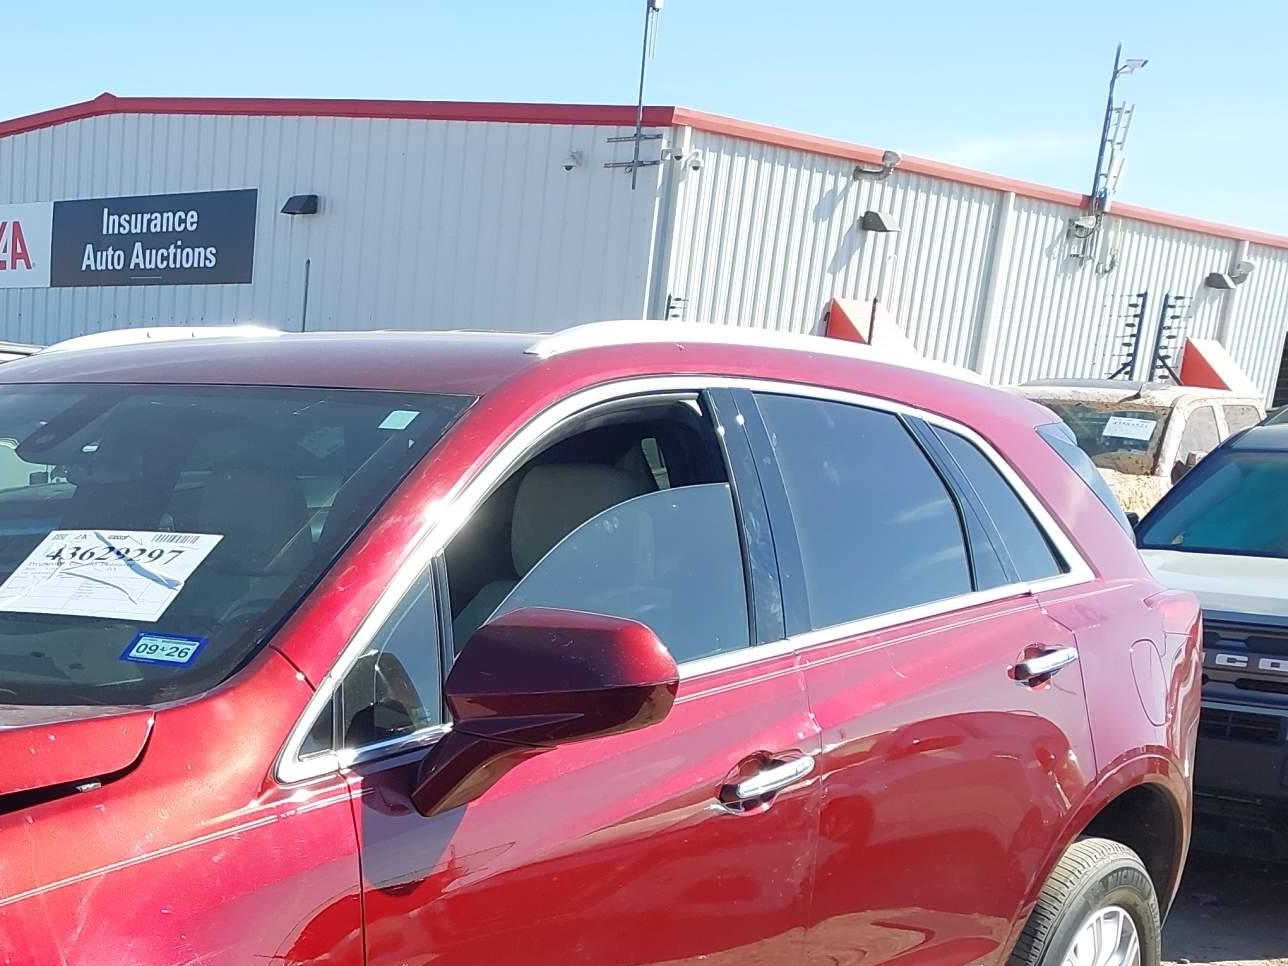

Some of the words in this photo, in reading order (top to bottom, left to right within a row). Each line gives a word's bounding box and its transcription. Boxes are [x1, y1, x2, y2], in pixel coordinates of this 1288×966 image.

[102, 207, 198, 235] Insurance
[81, 243, 125, 271] Auto
[129, 240, 217, 270] Auctions
[45, 544, 185, 566] 43629297
[1202, 651, 1288, 672] CO
